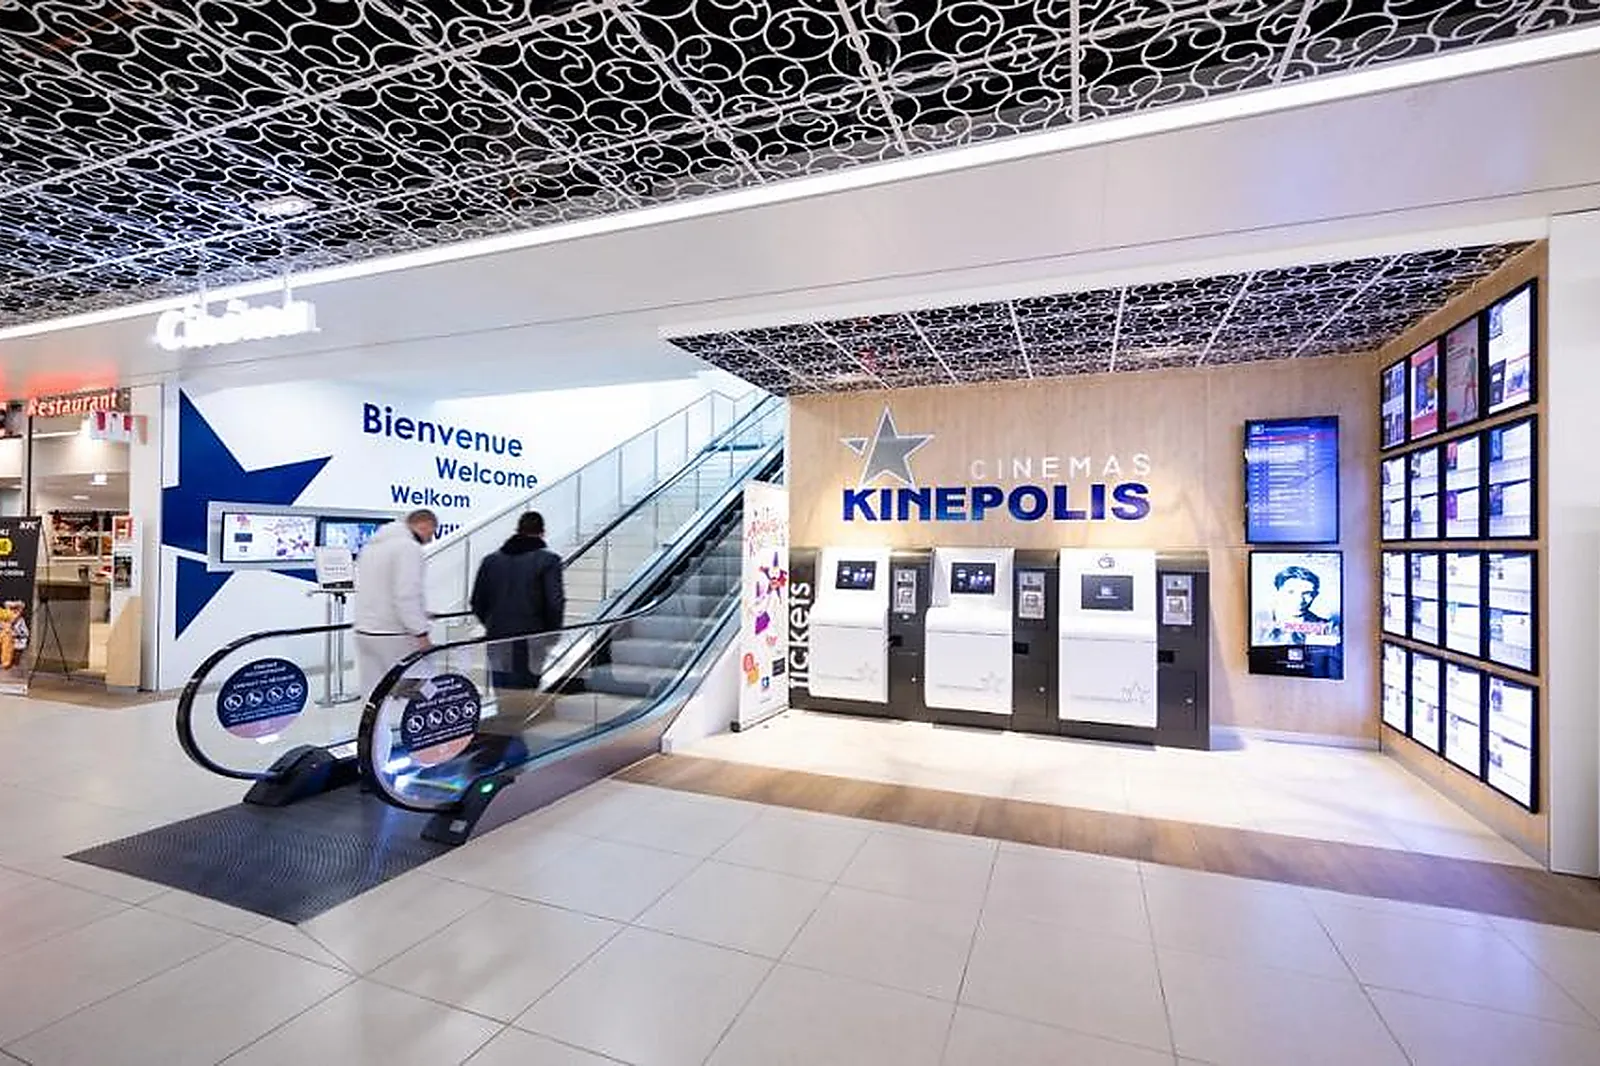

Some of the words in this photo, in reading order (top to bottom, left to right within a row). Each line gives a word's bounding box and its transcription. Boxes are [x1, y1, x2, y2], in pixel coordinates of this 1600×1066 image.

[27, 392, 117, 416] Restaurant
[363, 402, 523, 458] Bienvenue
[435, 456, 538, 489] Welcome
[970, 453, 1151, 480] CINEMAS
[391, 484, 470, 508] Welkom
[843, 482, 1152, 522] KINEPOLIS
